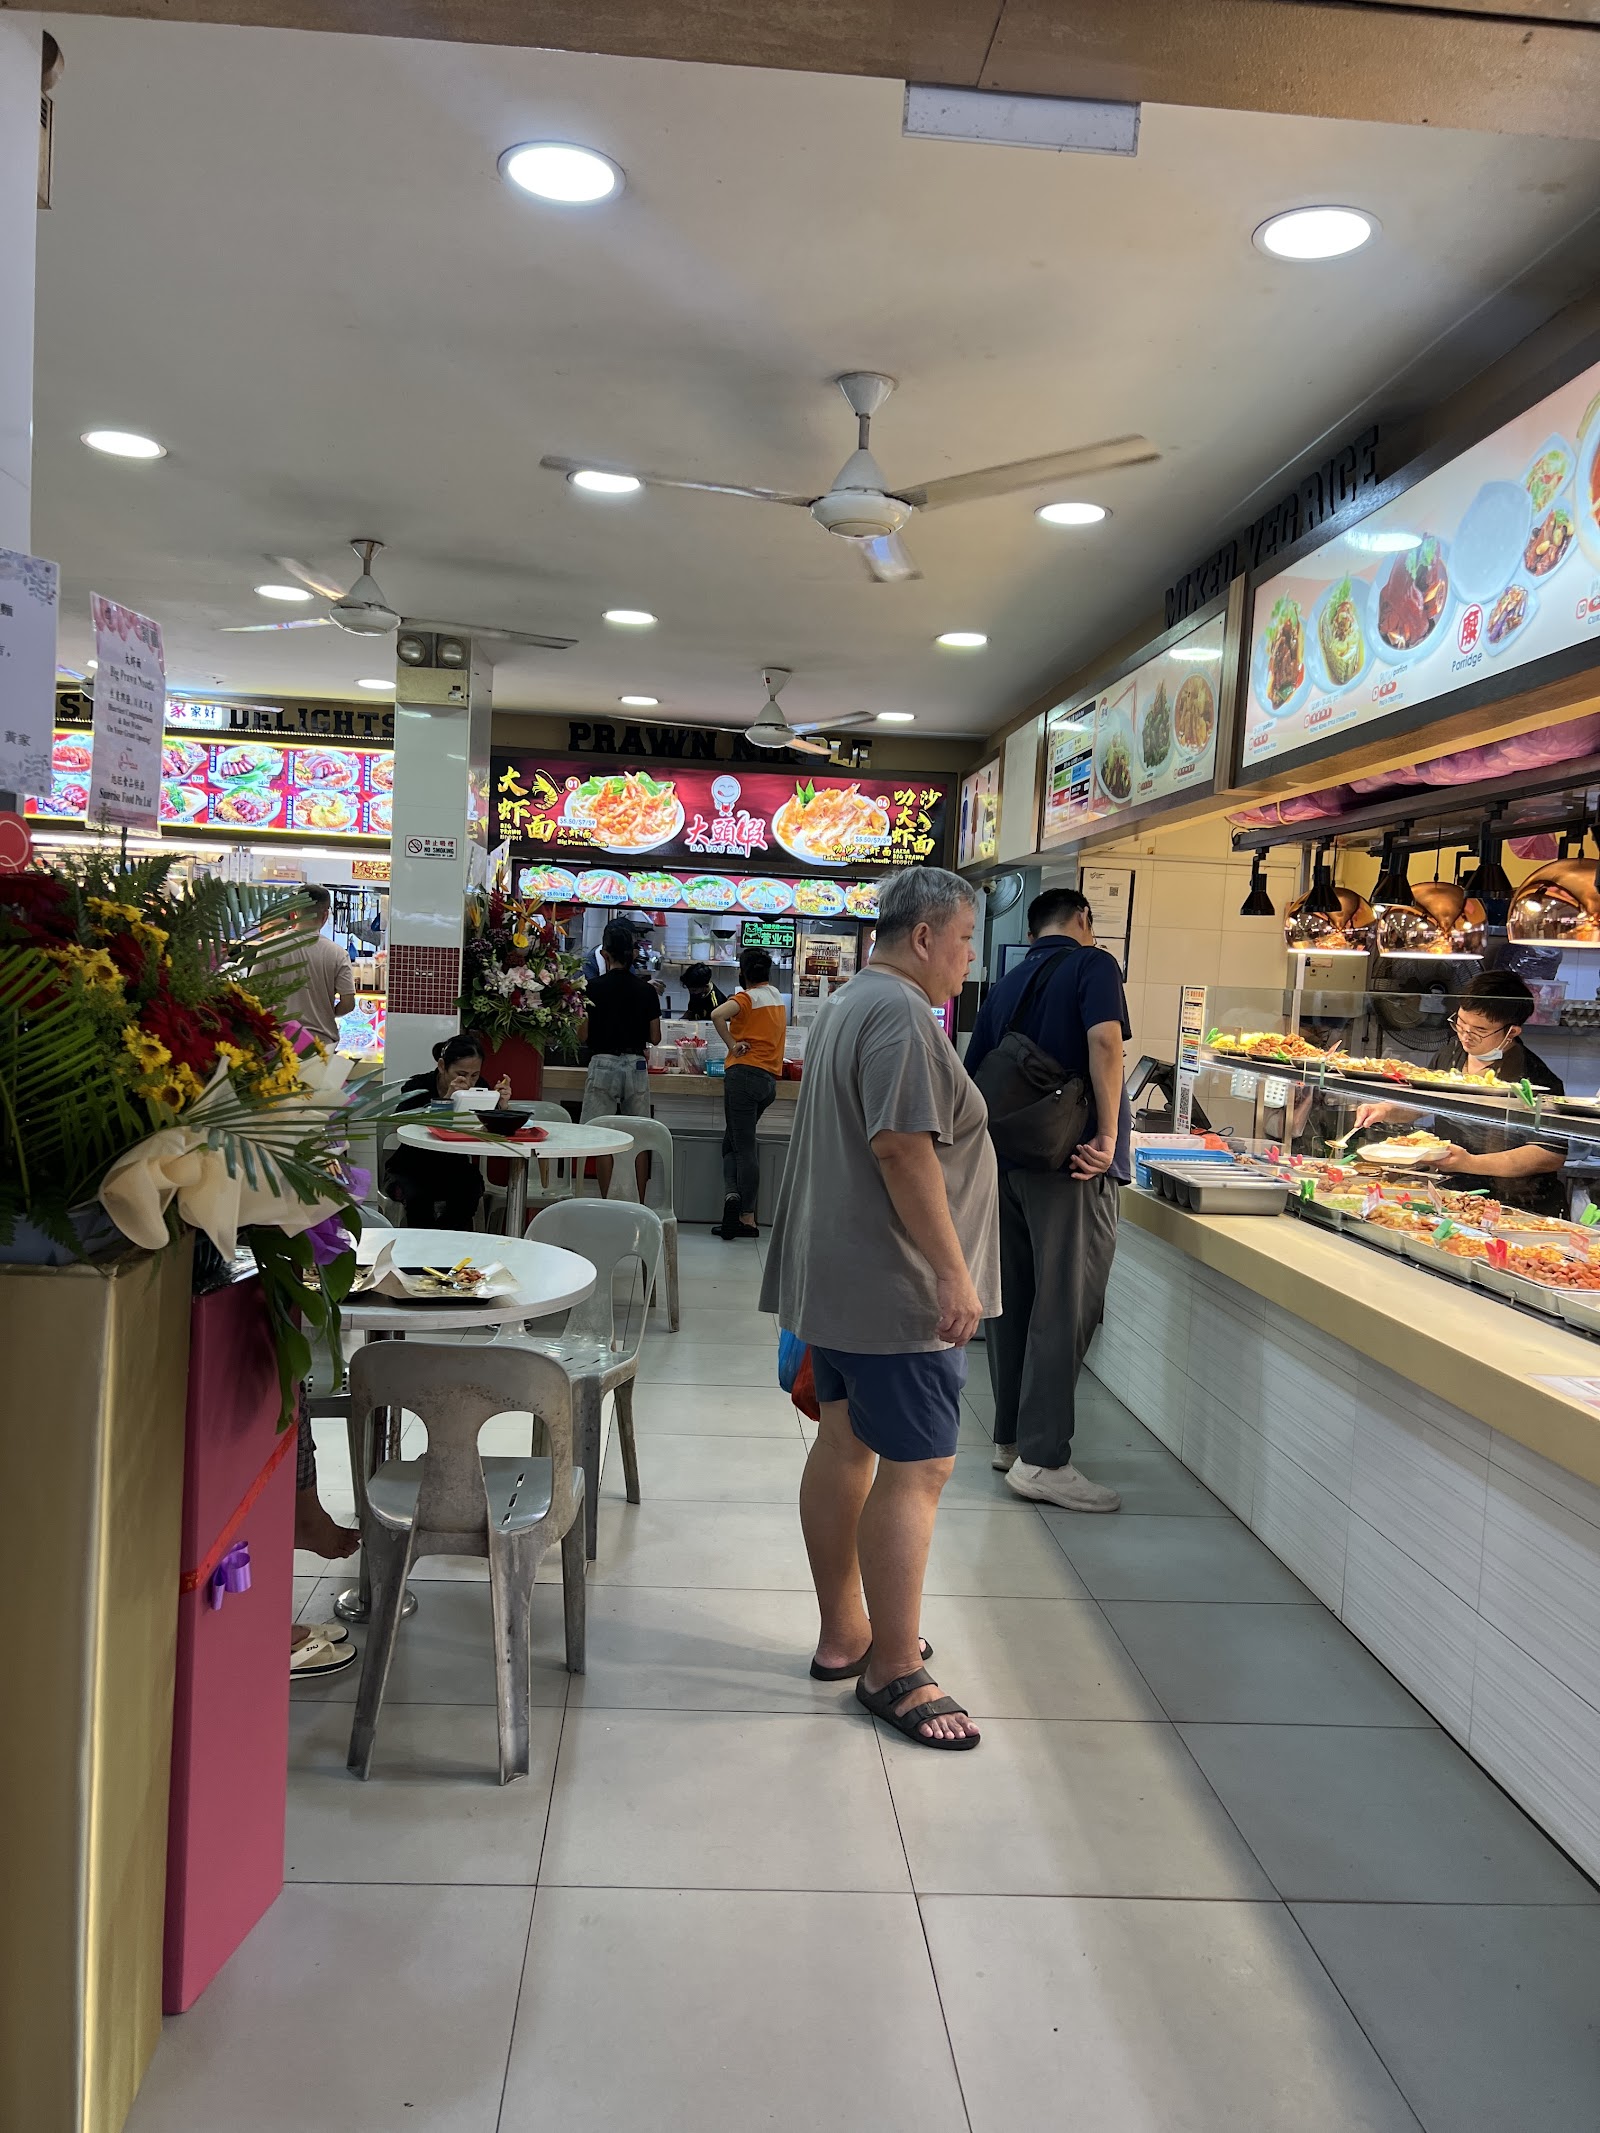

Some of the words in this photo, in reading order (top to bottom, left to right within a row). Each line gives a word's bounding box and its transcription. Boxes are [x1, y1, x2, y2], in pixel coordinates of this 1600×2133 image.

[1302, 424, 1379, 536] RICE
[1451, 652, 1483, 673] Porridge
[568, 722, 718, 761] PRAWN
[567, 780, 578, 789] 01
[99, 788, 121, 802] Sunrise
[121, 792, 134, 805] Food
[497, 765, 557, 843] 大虾面
[877, 799, 888, 808] 06
[558, 828, 592, 840] 大虾面
[557, 838, 567, 846] Big
[433, 847, 455, 855] SMOKING
[690, 843, 704, 853] DA
[706, 844, 725, 853] TOU
[727, 846, 746, 855] XIA
[761, 932, 793, 946] 营业中
